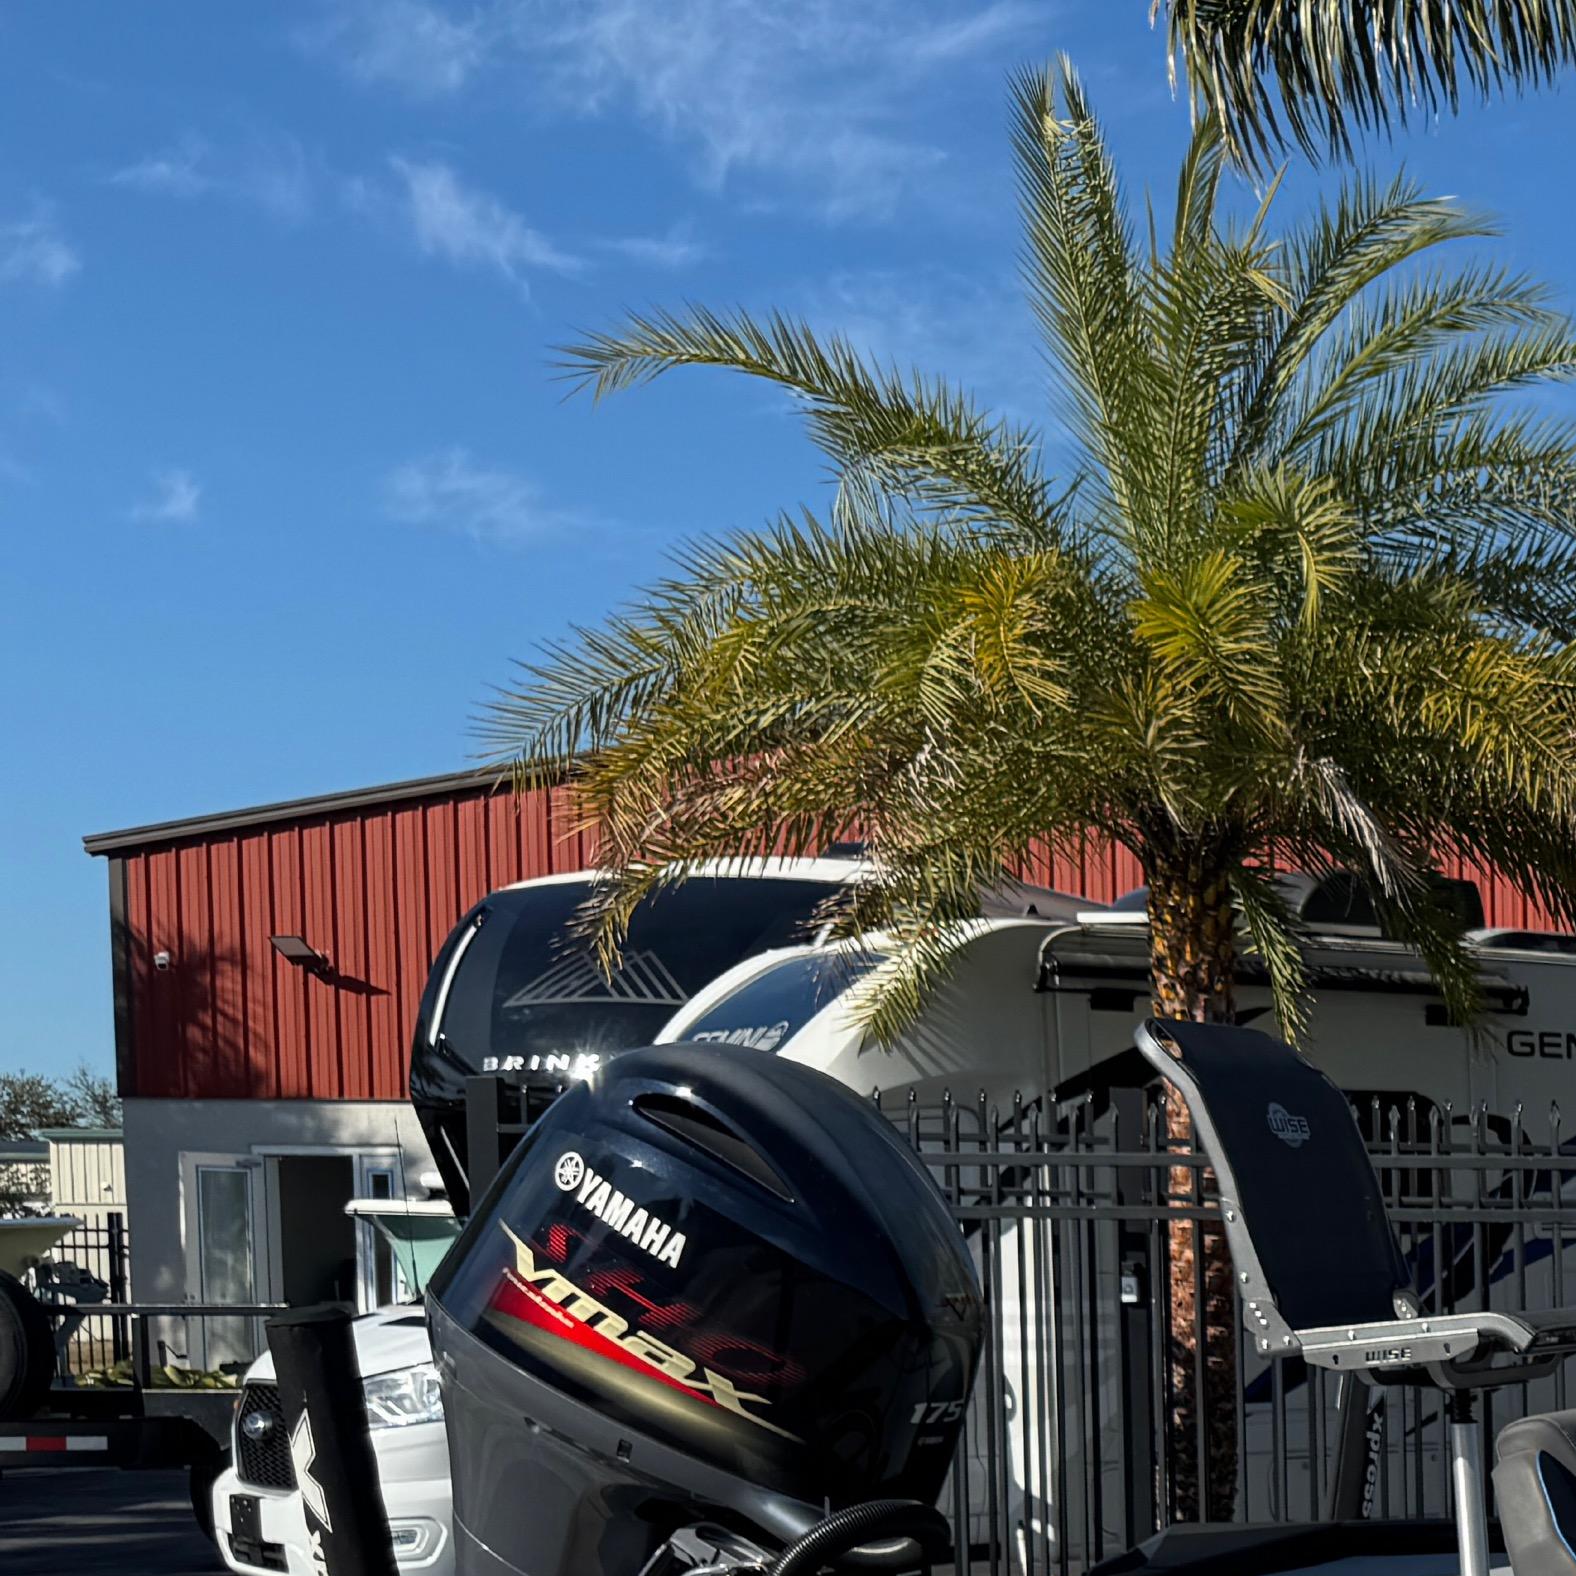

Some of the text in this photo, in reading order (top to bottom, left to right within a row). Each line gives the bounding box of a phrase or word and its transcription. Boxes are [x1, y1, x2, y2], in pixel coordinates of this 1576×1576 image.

[483, 1052, 602, 1073] BRINK
[1267, 1116, 1310, 1137] WISE
[576, 1167, 687, 1270] YAMAHA
[1365, 1347, 1412, 1364] WISE
[910, 1399, 965, 1424] 175
[1361, 1412, 1384, 1519] xpress
